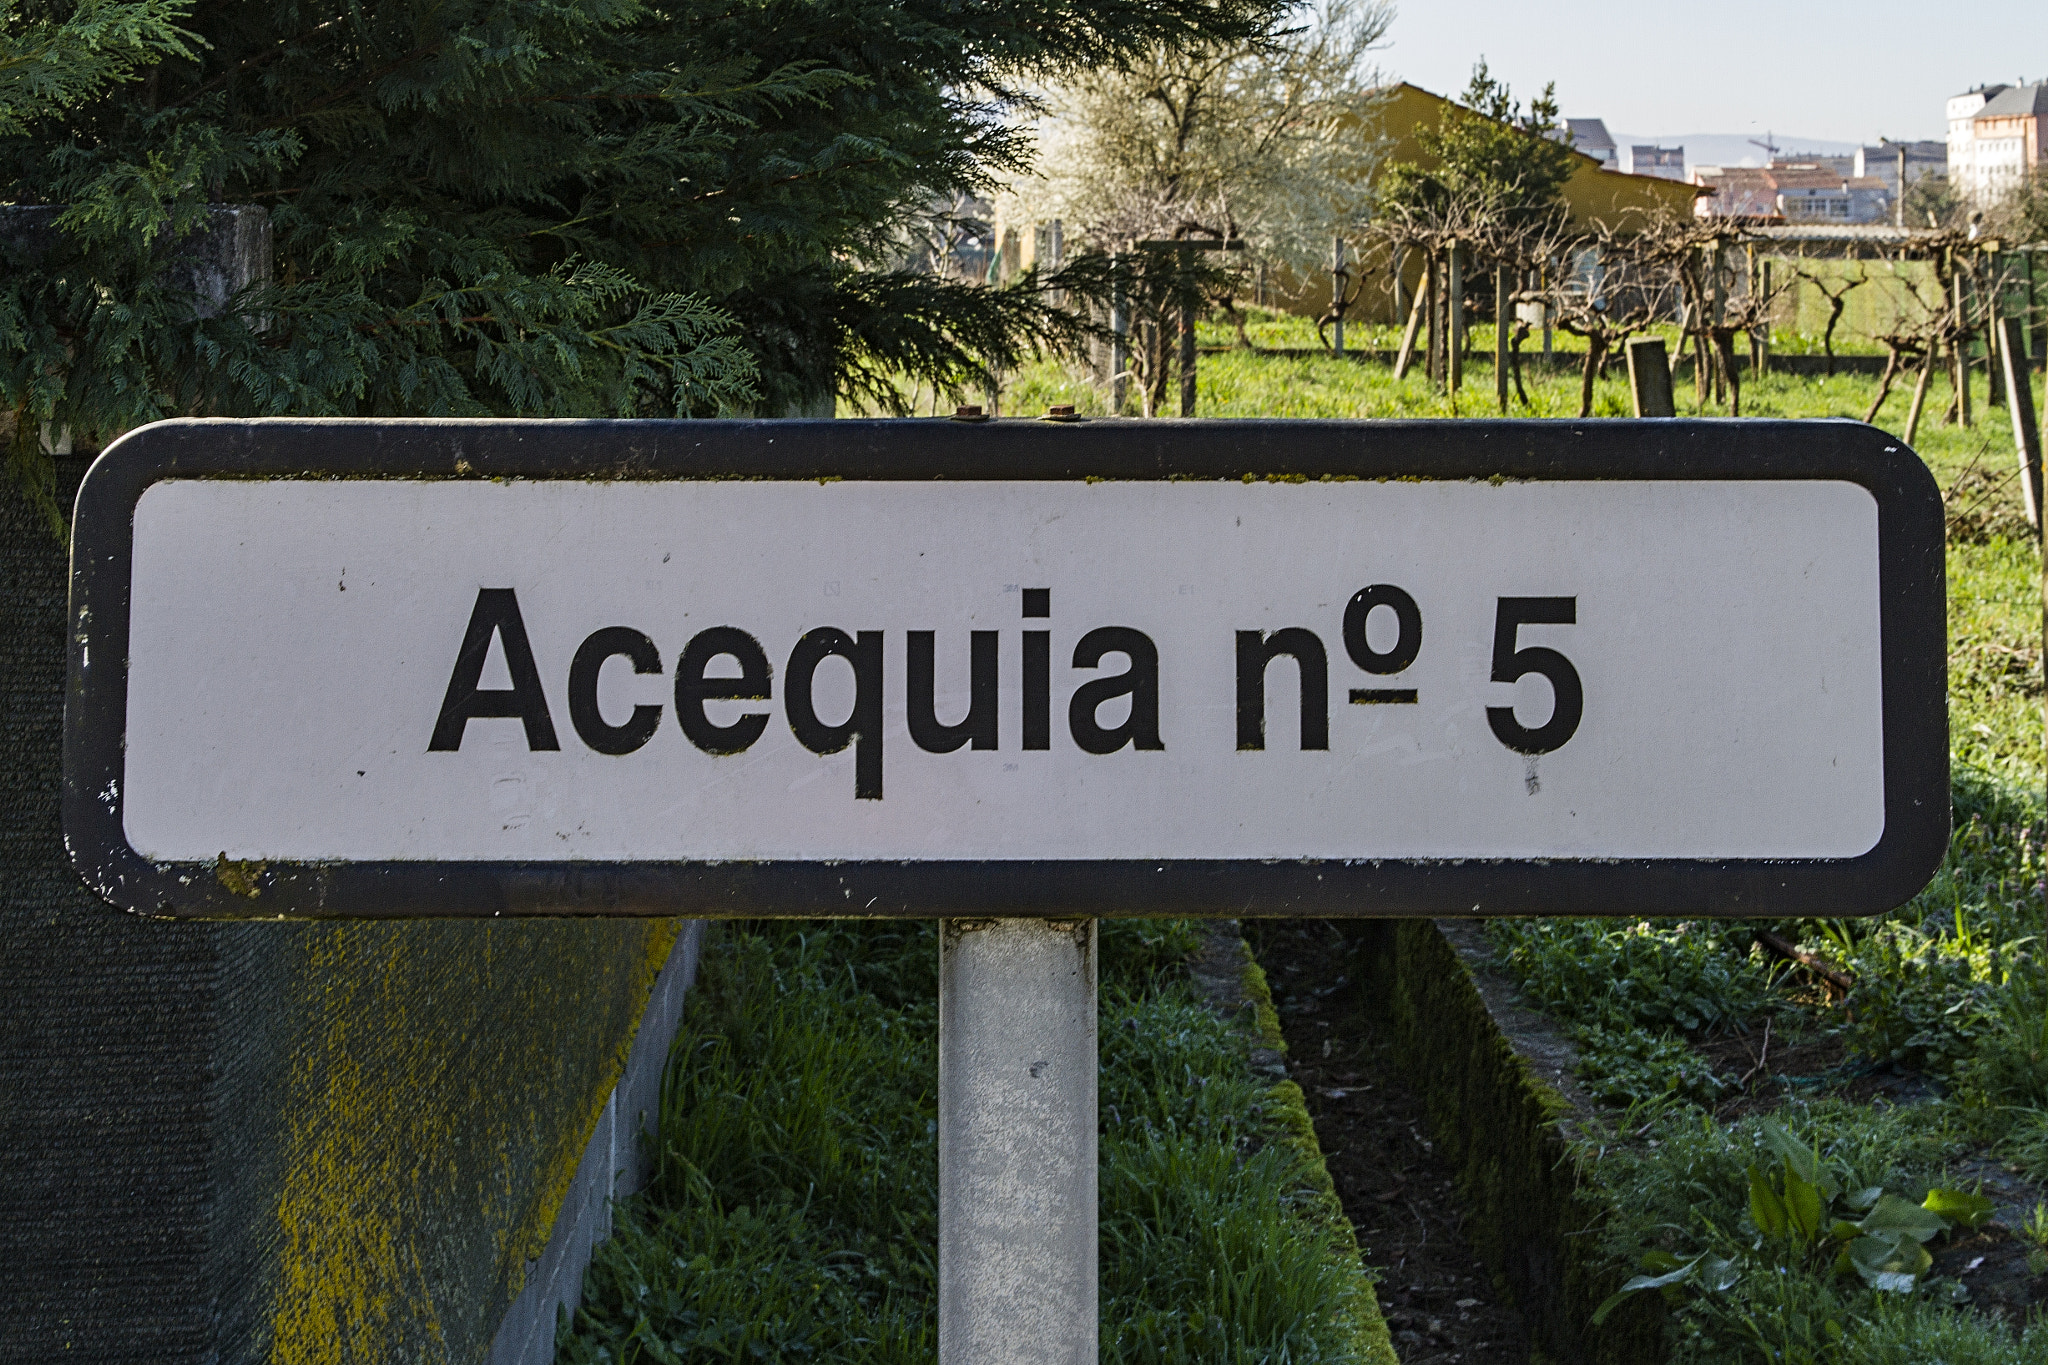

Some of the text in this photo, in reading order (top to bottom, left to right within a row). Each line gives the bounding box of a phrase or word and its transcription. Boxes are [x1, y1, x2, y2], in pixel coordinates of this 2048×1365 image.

[423, 583, 1584, 801] Acequia nº 5
